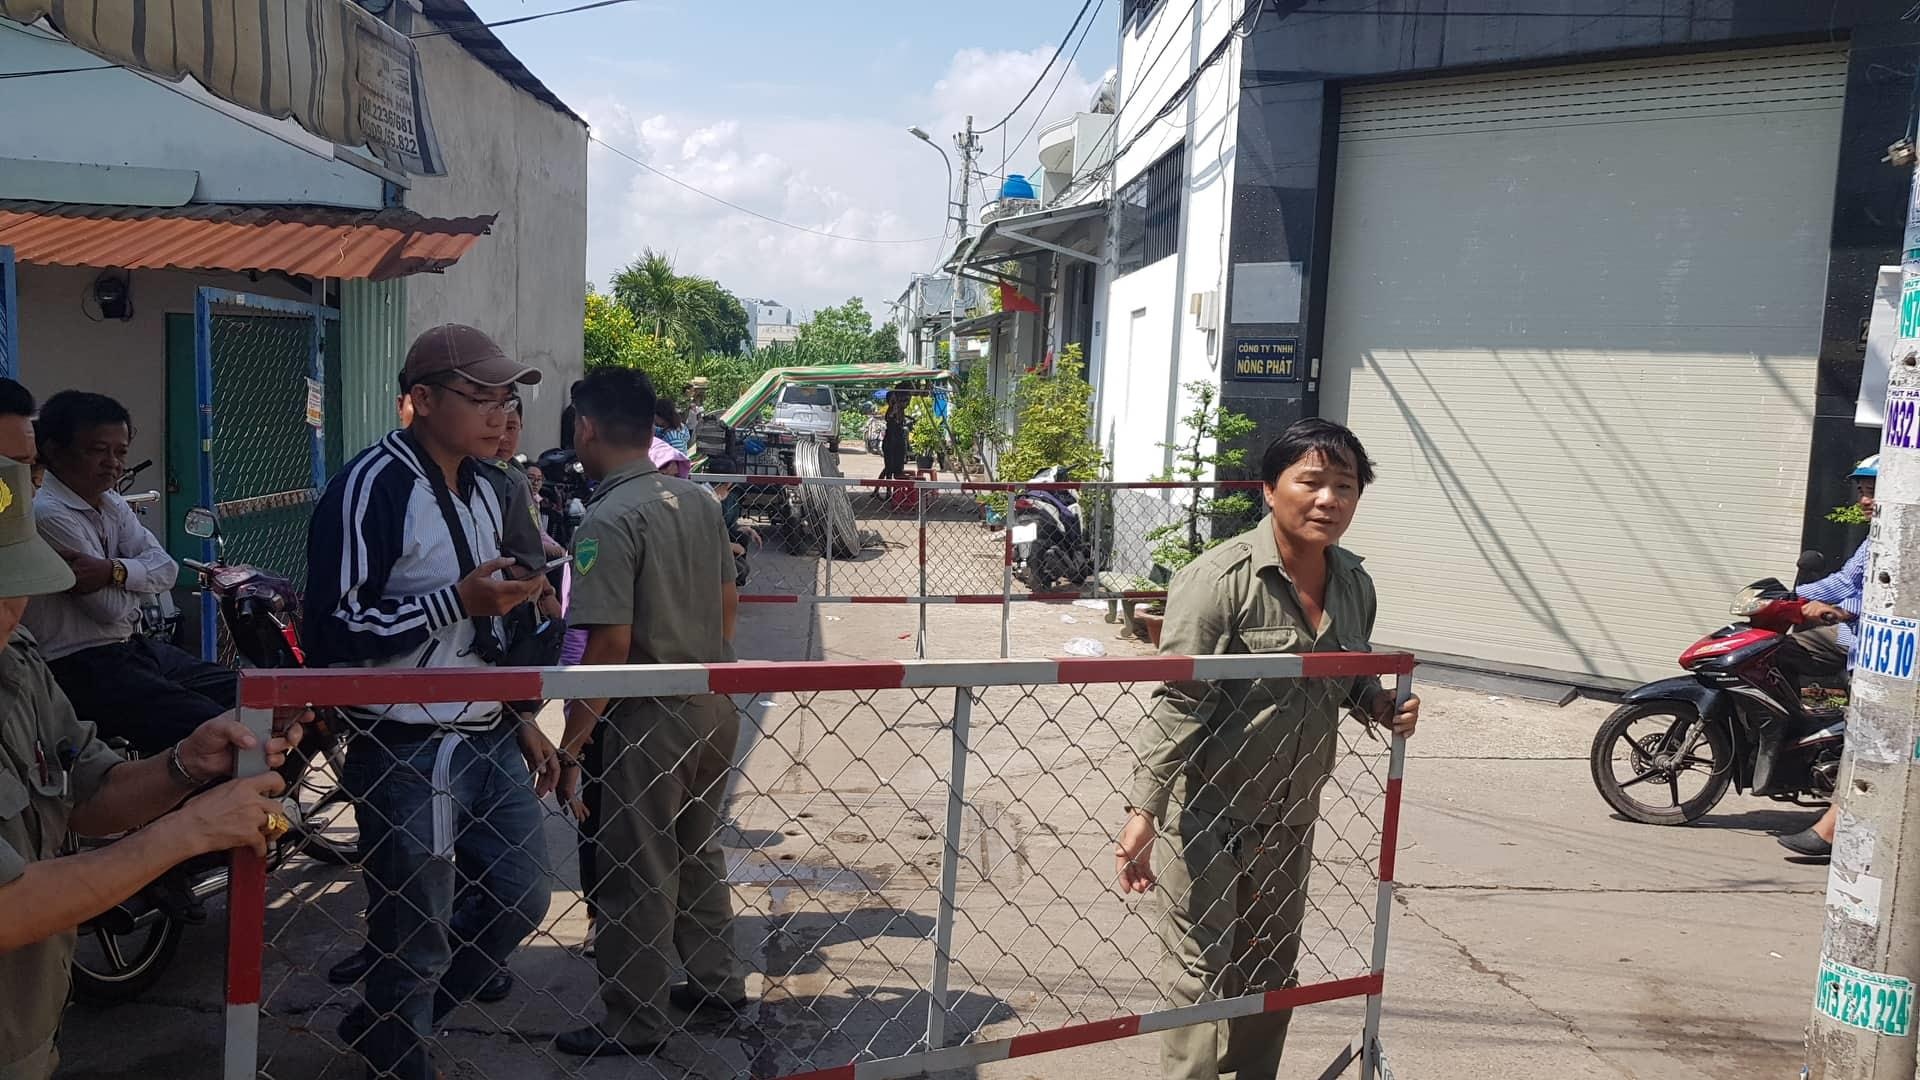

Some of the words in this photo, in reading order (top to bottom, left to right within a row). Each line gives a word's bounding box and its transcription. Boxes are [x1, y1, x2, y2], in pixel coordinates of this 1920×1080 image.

[1238, 342, 1259, 353] CÔNG
[1260, 344, 1271, 353] TY
[1272, 344, 1293, 353] TNHH
[1237, 355, 1264, 375] NÔNG
[1265, 356, 1293, 375] PHÁT
